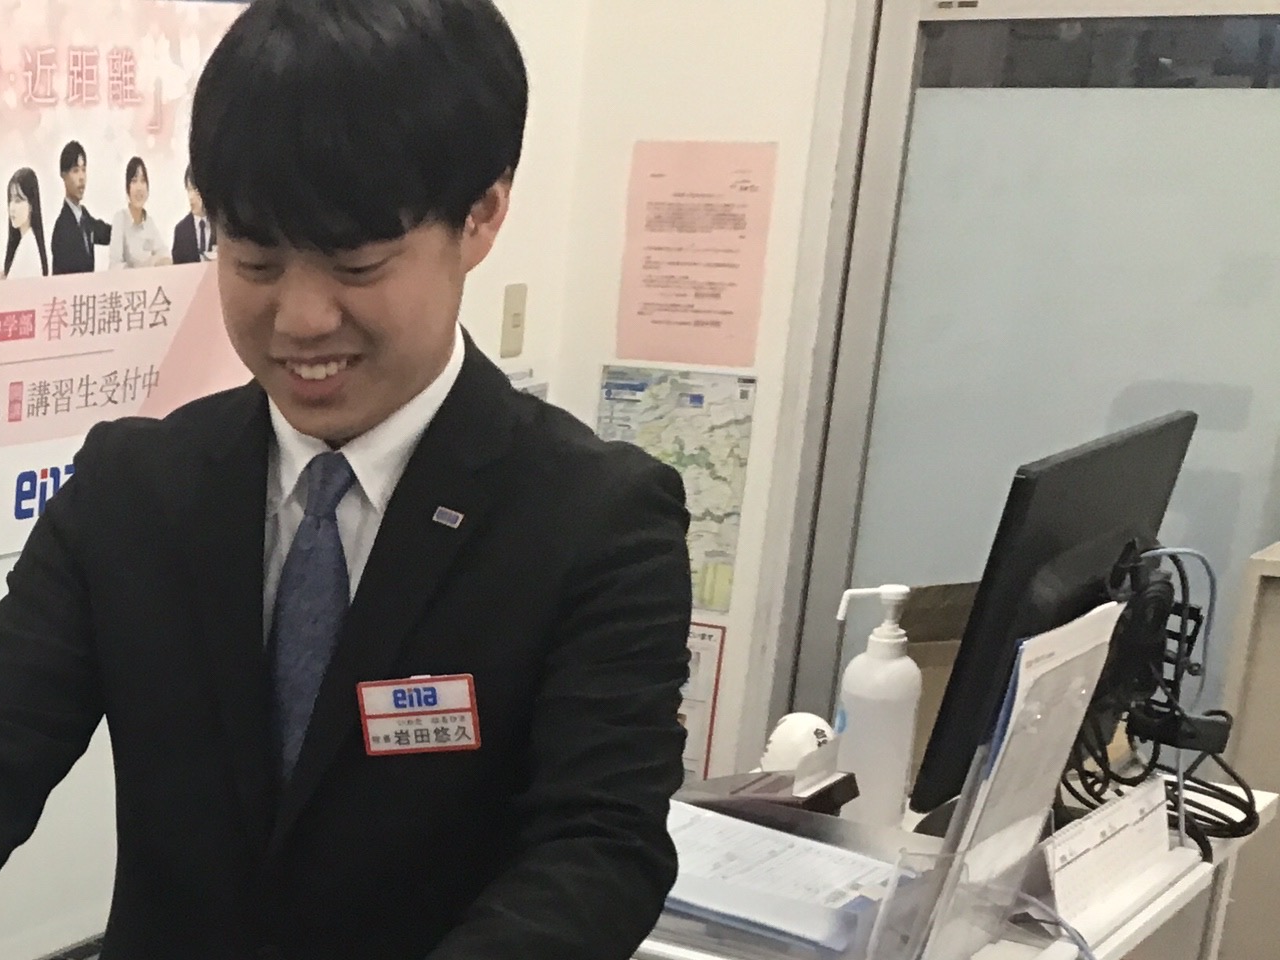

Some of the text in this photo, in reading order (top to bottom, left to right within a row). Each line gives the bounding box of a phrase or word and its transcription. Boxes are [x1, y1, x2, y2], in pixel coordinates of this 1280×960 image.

[42, 286, 172, 341] 春期講習会
[27, 365, 160, 418] 講習生受付中
[392, 686, 438, 709] ena
[394, 725, 472, 745] 岩田悠久
